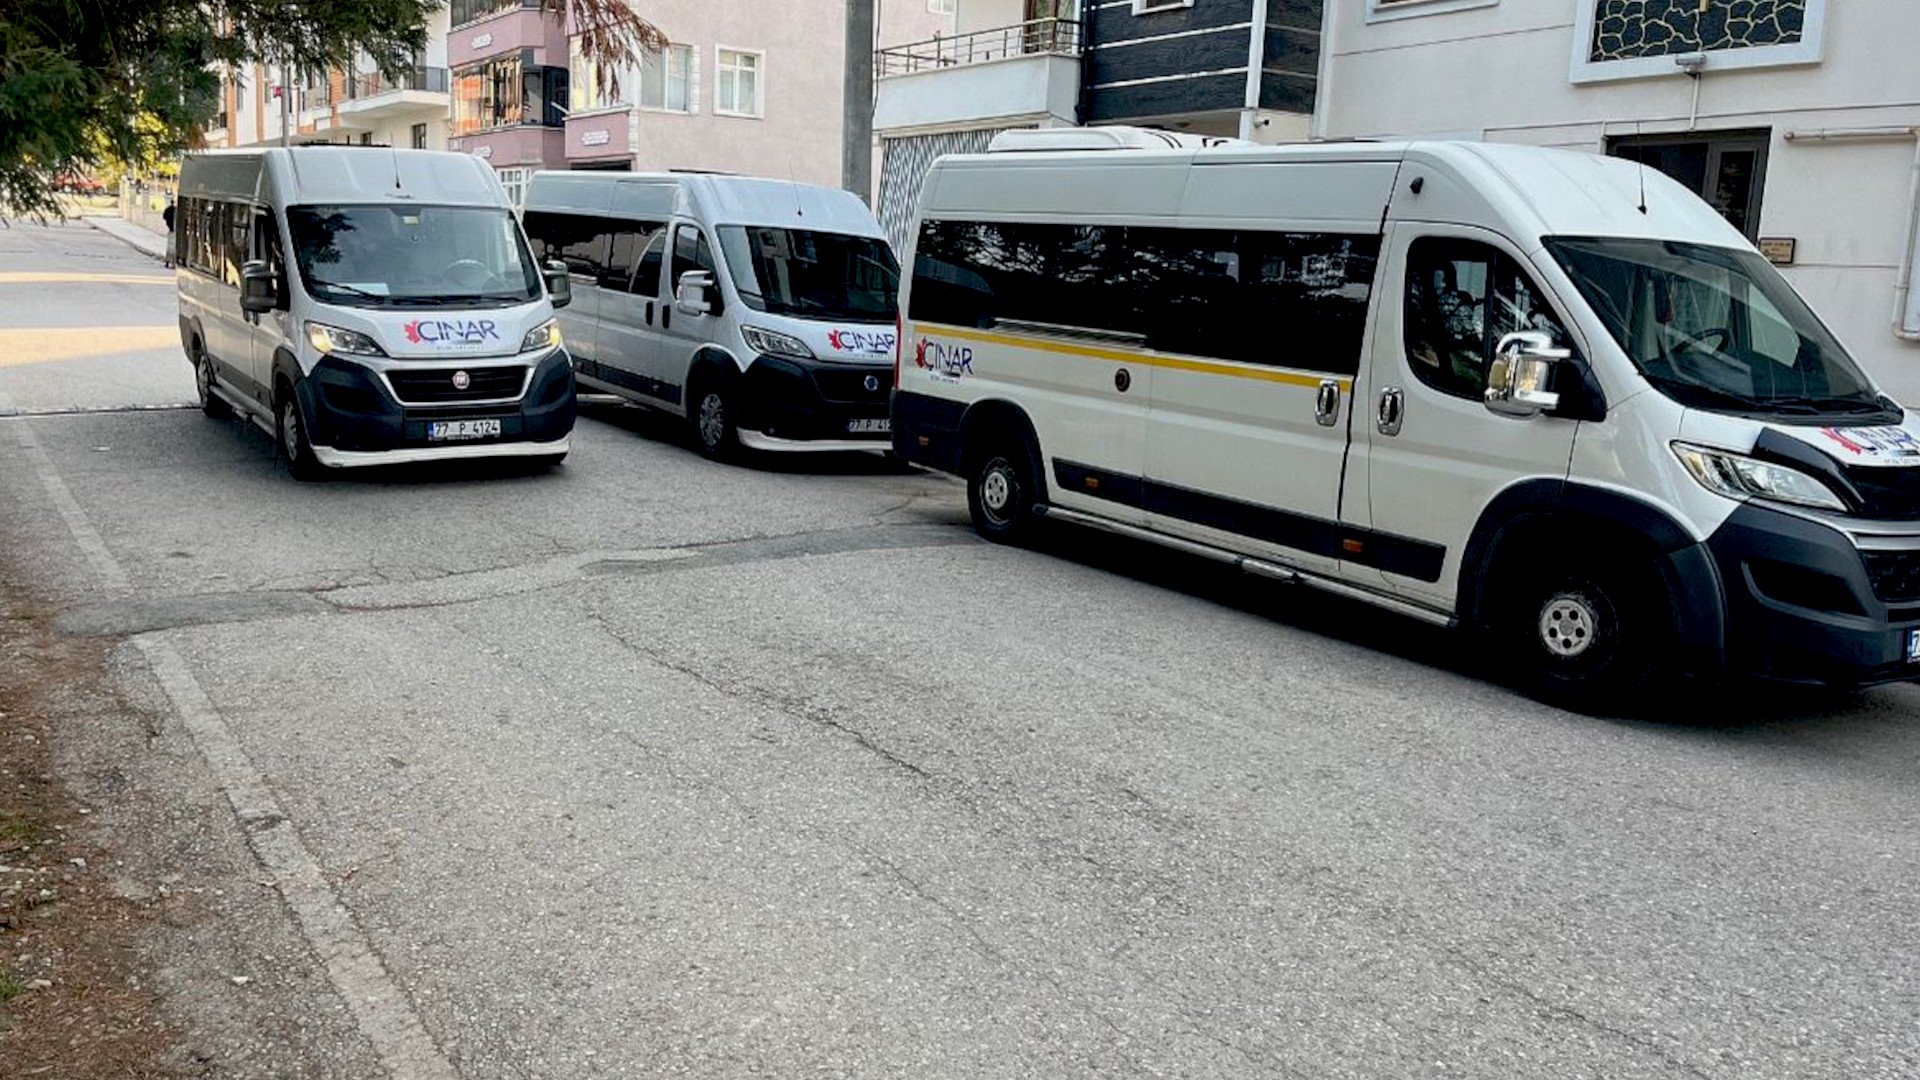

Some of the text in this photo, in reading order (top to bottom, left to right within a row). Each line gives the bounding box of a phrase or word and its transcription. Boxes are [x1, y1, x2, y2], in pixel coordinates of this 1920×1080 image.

[436, 421, 498, 434] 77 P 4124
